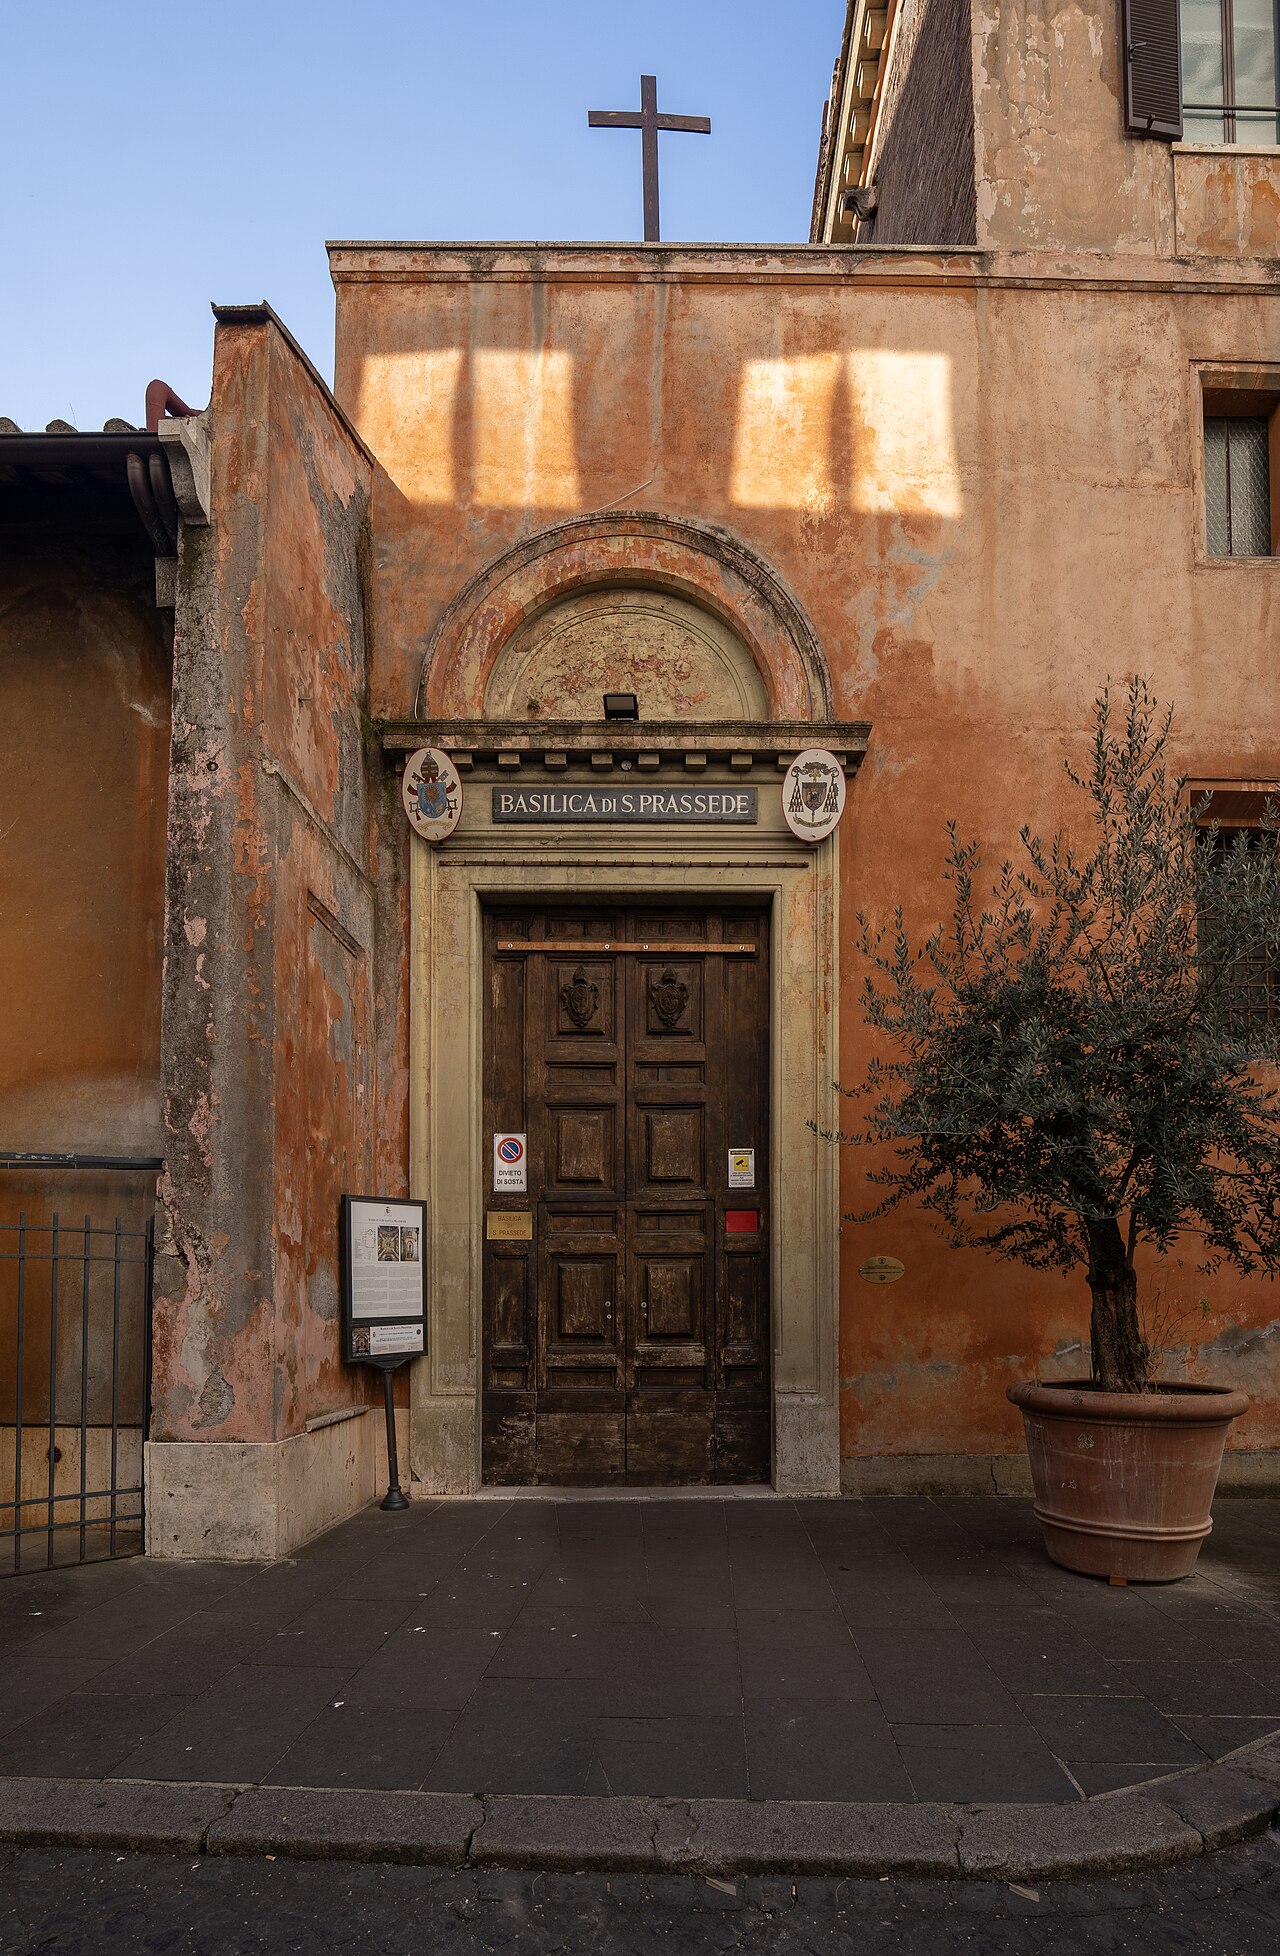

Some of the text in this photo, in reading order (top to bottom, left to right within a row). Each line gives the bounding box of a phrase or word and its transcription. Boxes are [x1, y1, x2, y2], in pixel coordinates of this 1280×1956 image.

[500, 793, 750, 814] BASILICA DI S. PRASSEDE
